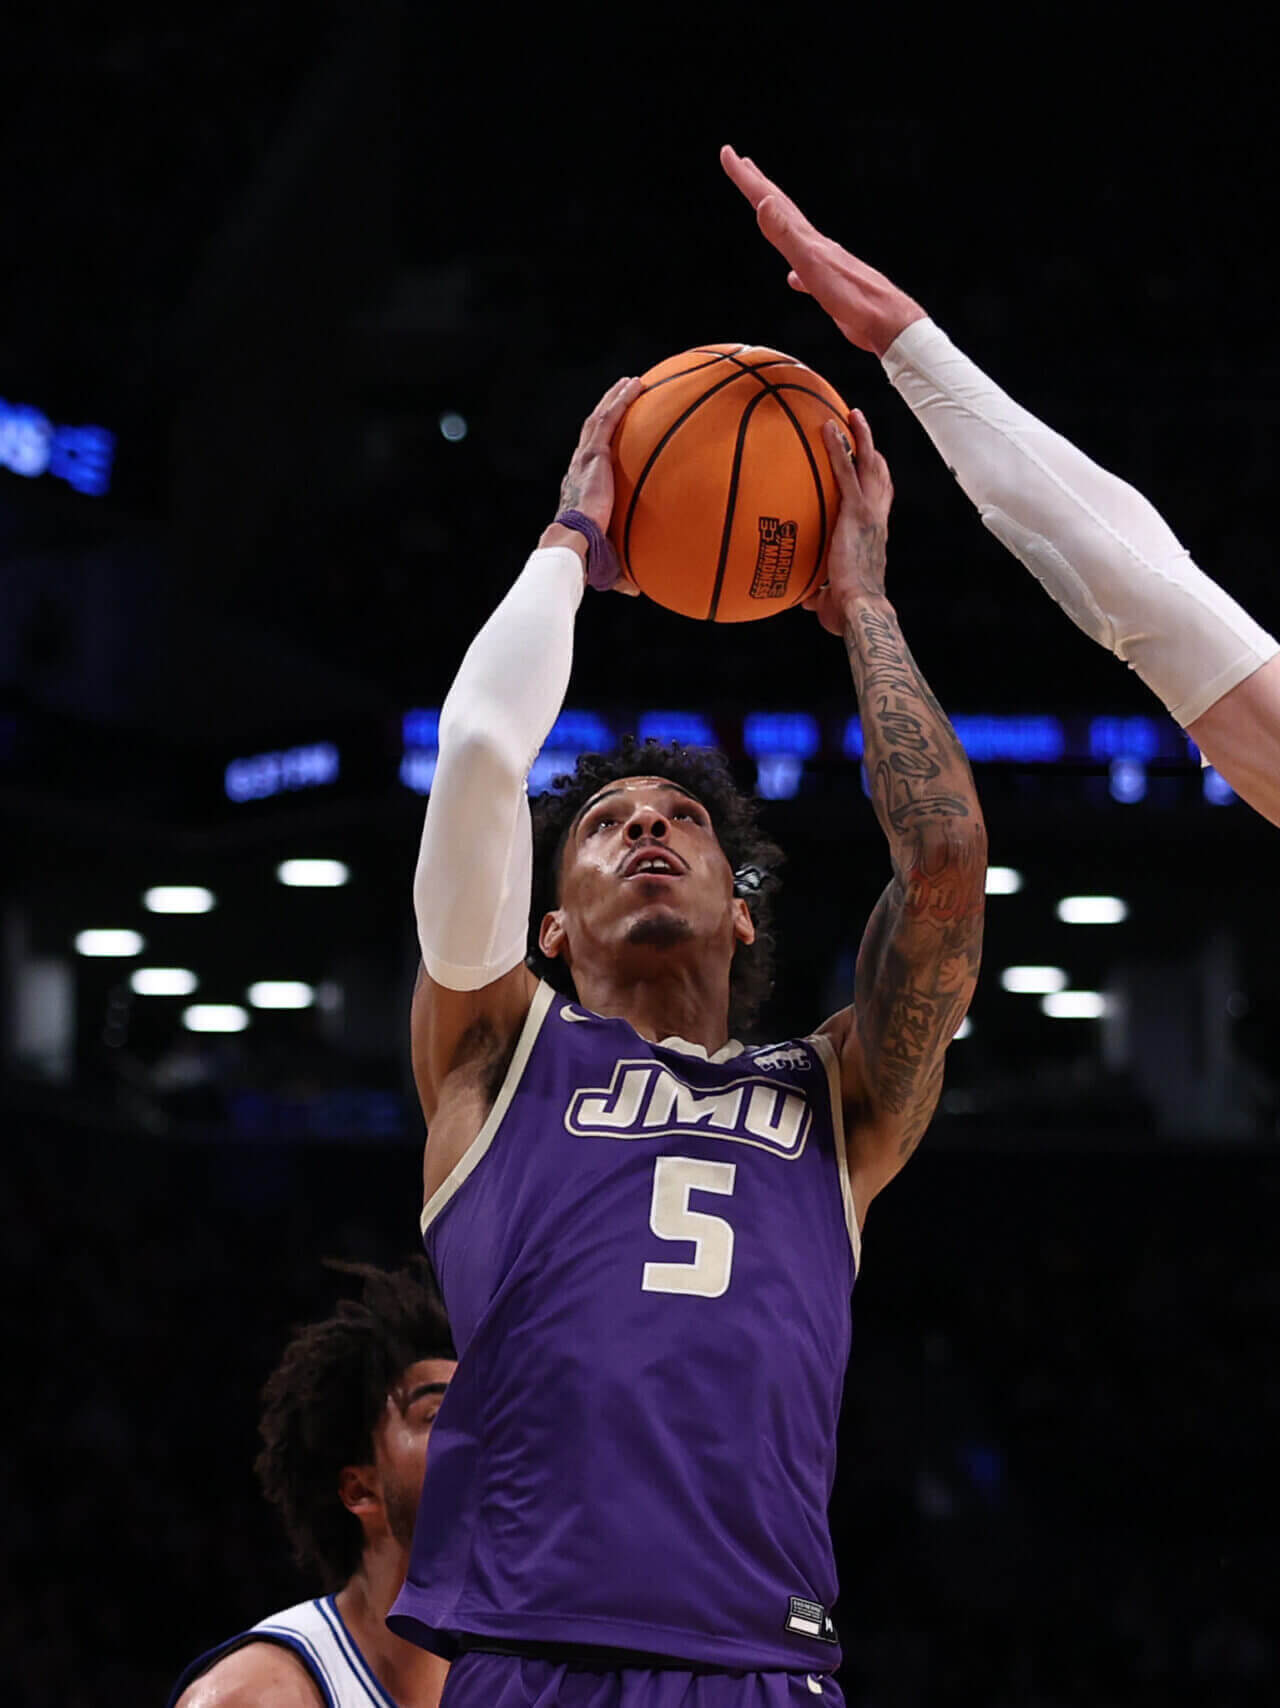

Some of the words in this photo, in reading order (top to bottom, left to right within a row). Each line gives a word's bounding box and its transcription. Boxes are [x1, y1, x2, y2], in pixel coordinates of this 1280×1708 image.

[753, 544, 779, 598] MADNESS
[774, 537, 795, 582] MARCH
[576, 1068, 806, 1150] JMU
[641, 1155, 737, 1298] 5
